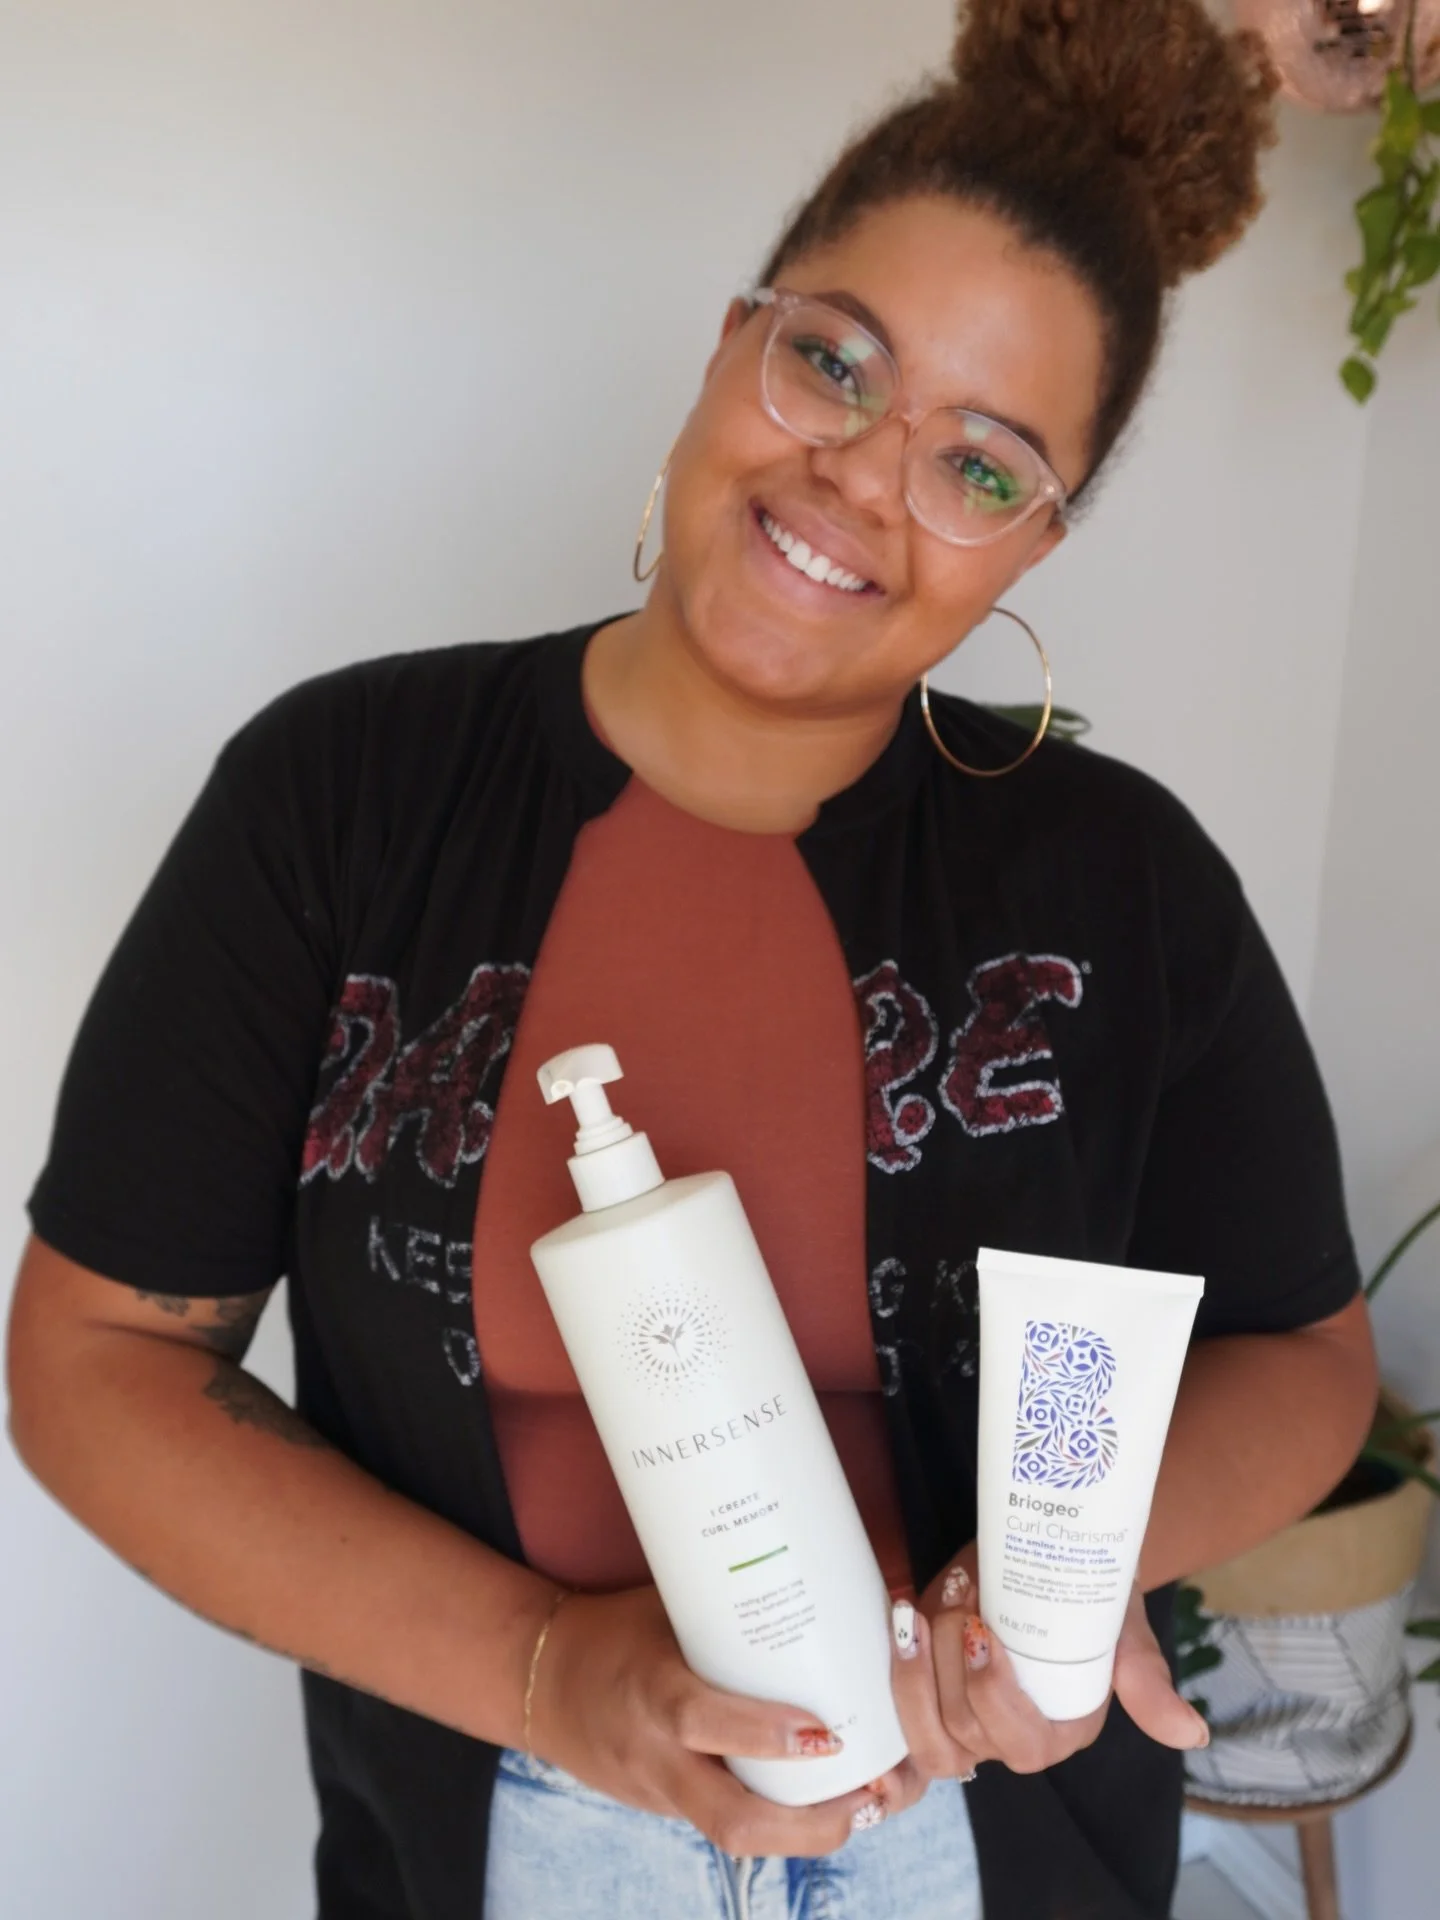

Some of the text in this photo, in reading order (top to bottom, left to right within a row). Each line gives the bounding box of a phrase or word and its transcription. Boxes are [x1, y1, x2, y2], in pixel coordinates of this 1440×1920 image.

[631, 1393, 787, 1469] INNERSENSE
[718, 1491, 760, 1515] CREATE
[701, 1501, 780, 1538] CURL MEMORY
[1006, 1515, 1041, 1535] Curl
